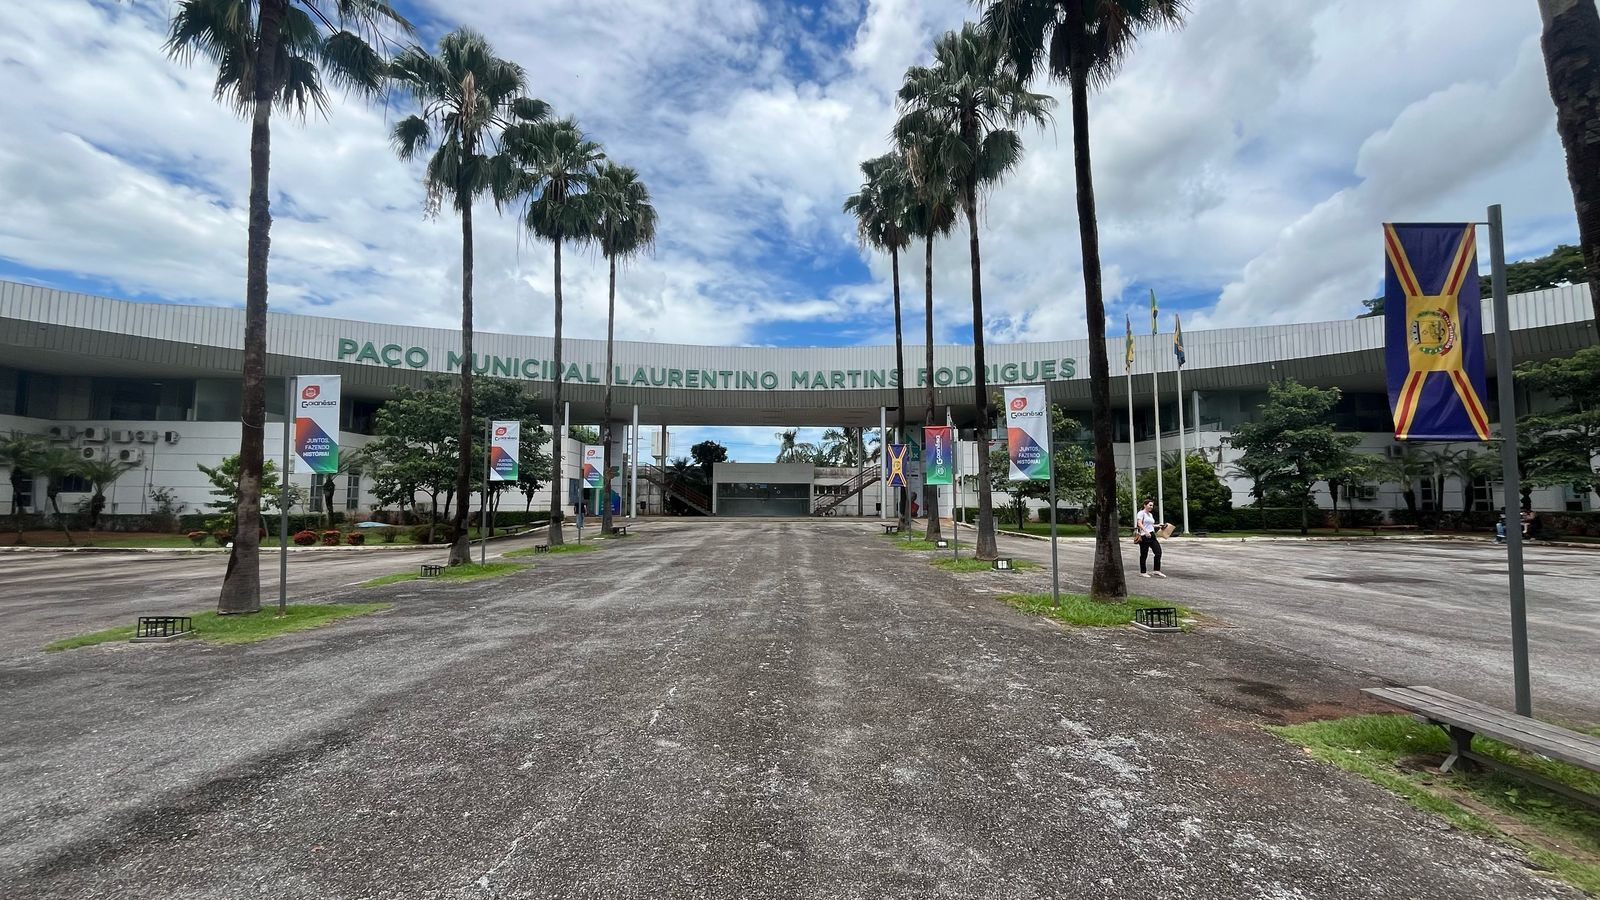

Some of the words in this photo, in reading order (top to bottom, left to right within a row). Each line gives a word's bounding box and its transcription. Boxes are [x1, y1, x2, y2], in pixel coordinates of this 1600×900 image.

[337, 337, 429, 369] PAÇO
[615, 366, 779, 389] LAURENTINO
[791, 368, 900, 389] MARTINS
